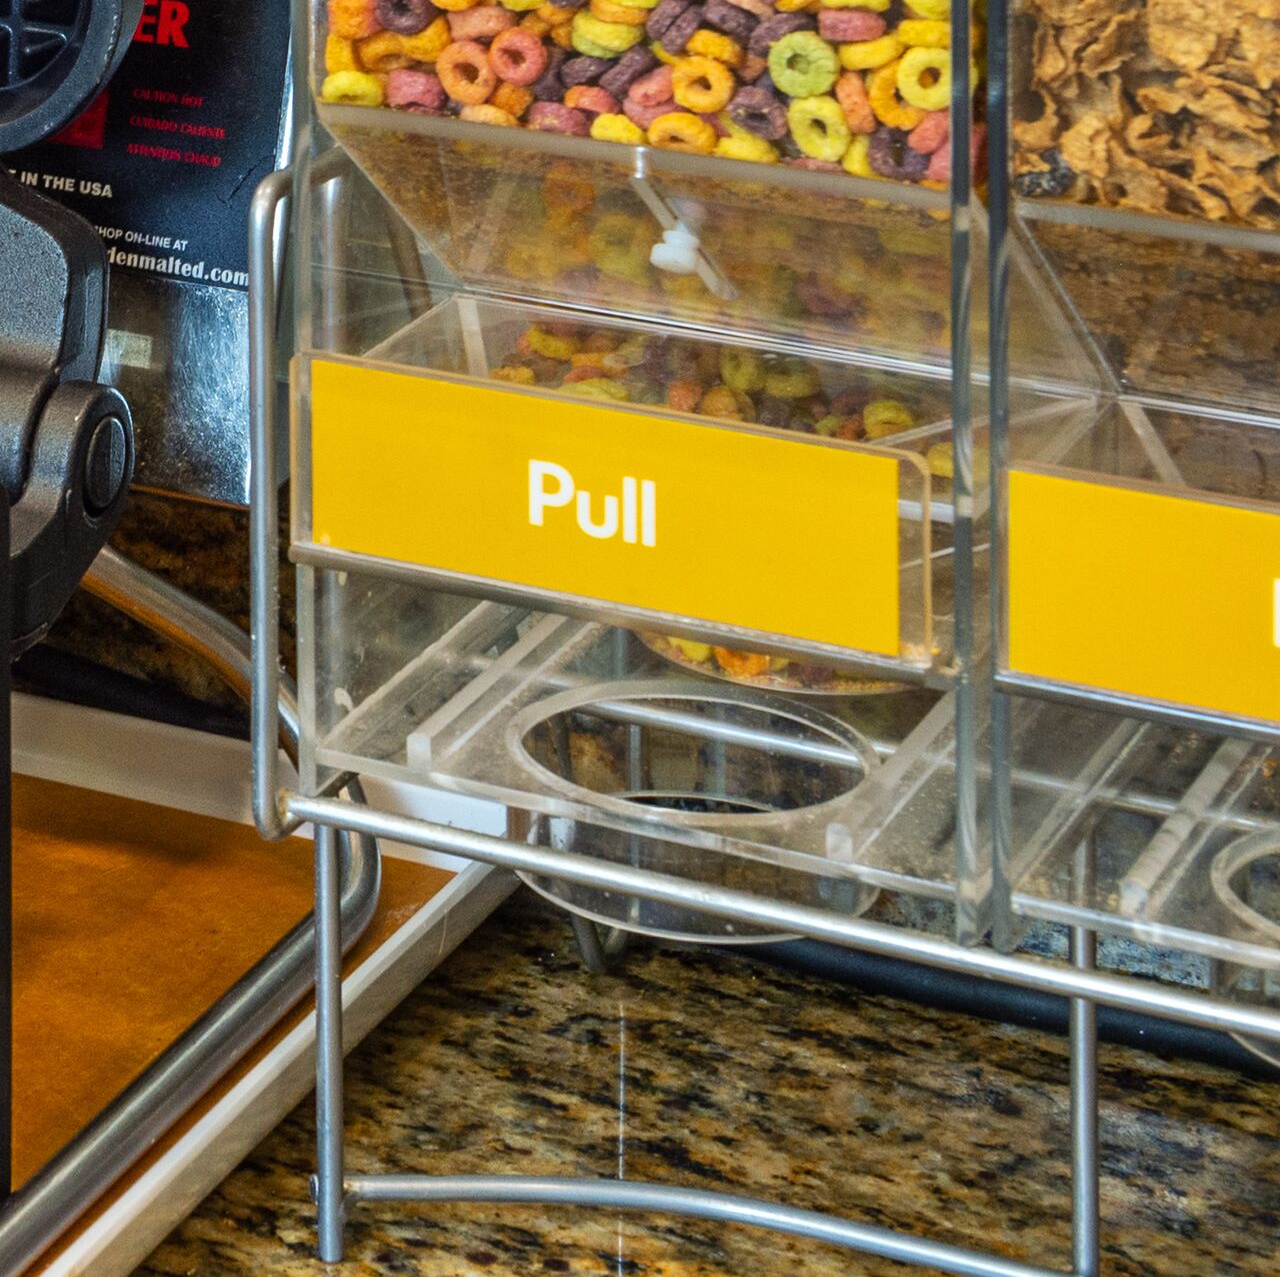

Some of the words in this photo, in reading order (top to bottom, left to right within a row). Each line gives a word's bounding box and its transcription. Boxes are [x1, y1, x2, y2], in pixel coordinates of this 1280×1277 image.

[20, 171, 38, 186] IN
[42, 174, 76, 192] THE
[80, 180, 112, 198] USA
[125, 230, 172, 249] ON-LINE
[172, 239, 188, 252] AT
[527, 458, 658, 548] Pull
